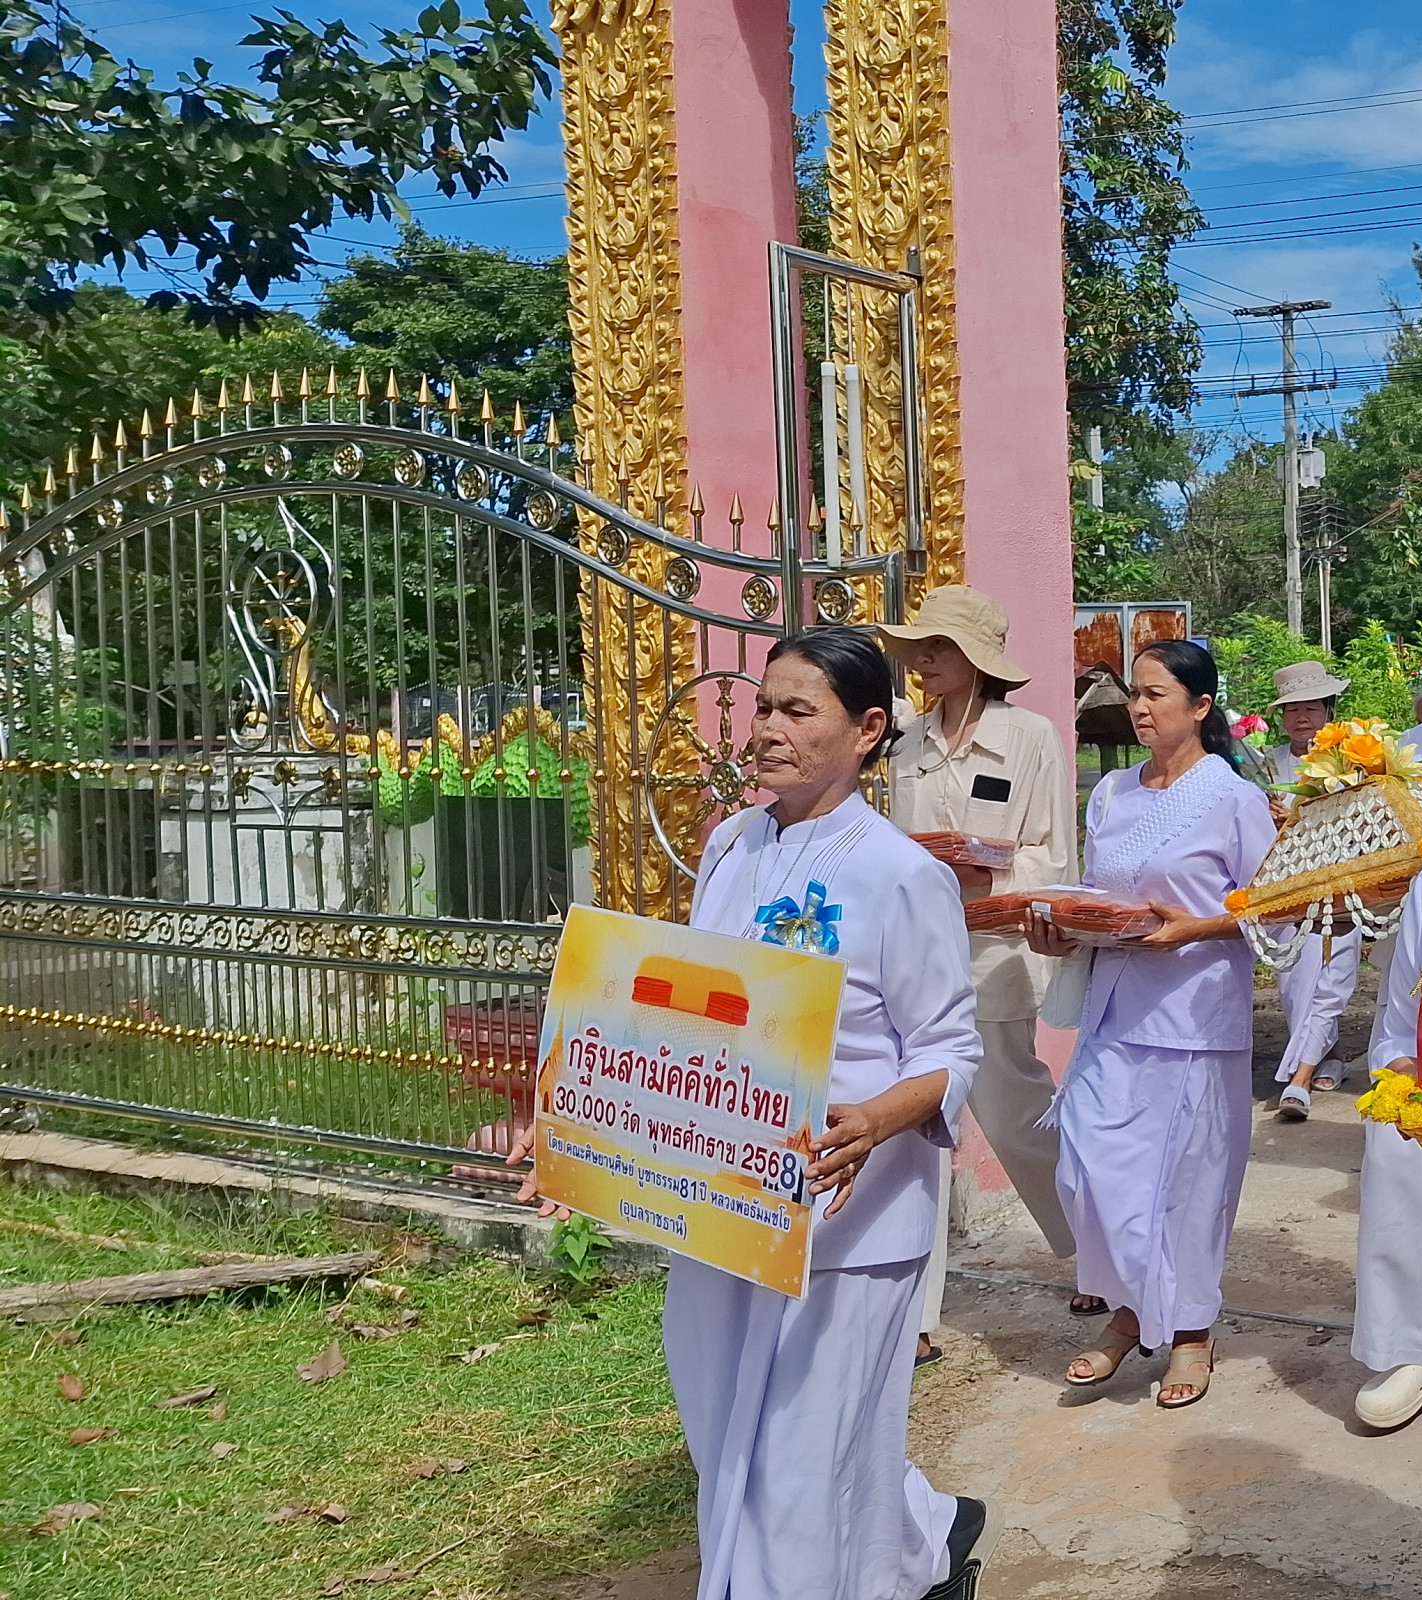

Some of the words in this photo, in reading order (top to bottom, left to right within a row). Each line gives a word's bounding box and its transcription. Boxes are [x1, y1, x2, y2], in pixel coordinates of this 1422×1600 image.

[569, 1027, 790, 1128] กฐินสามัคคีทั่วไทย
[547, 1128, 563, 1151] โดย
[567, 1143, 635, 1177] คณะศิษยานุศิษย์
[710, 1191, 790, 1231] หลวงพ่อธัมมชโย
[556, 1086, 616, 1127] 30,000
[620, 1100, 640, 1134] วัด
[648, 1118, 736, 1165] พุทธศักราช
[741, 1143, 797, 1190] 2568
[619, 1199, 687, 1241] (อุบลราชธานี)
